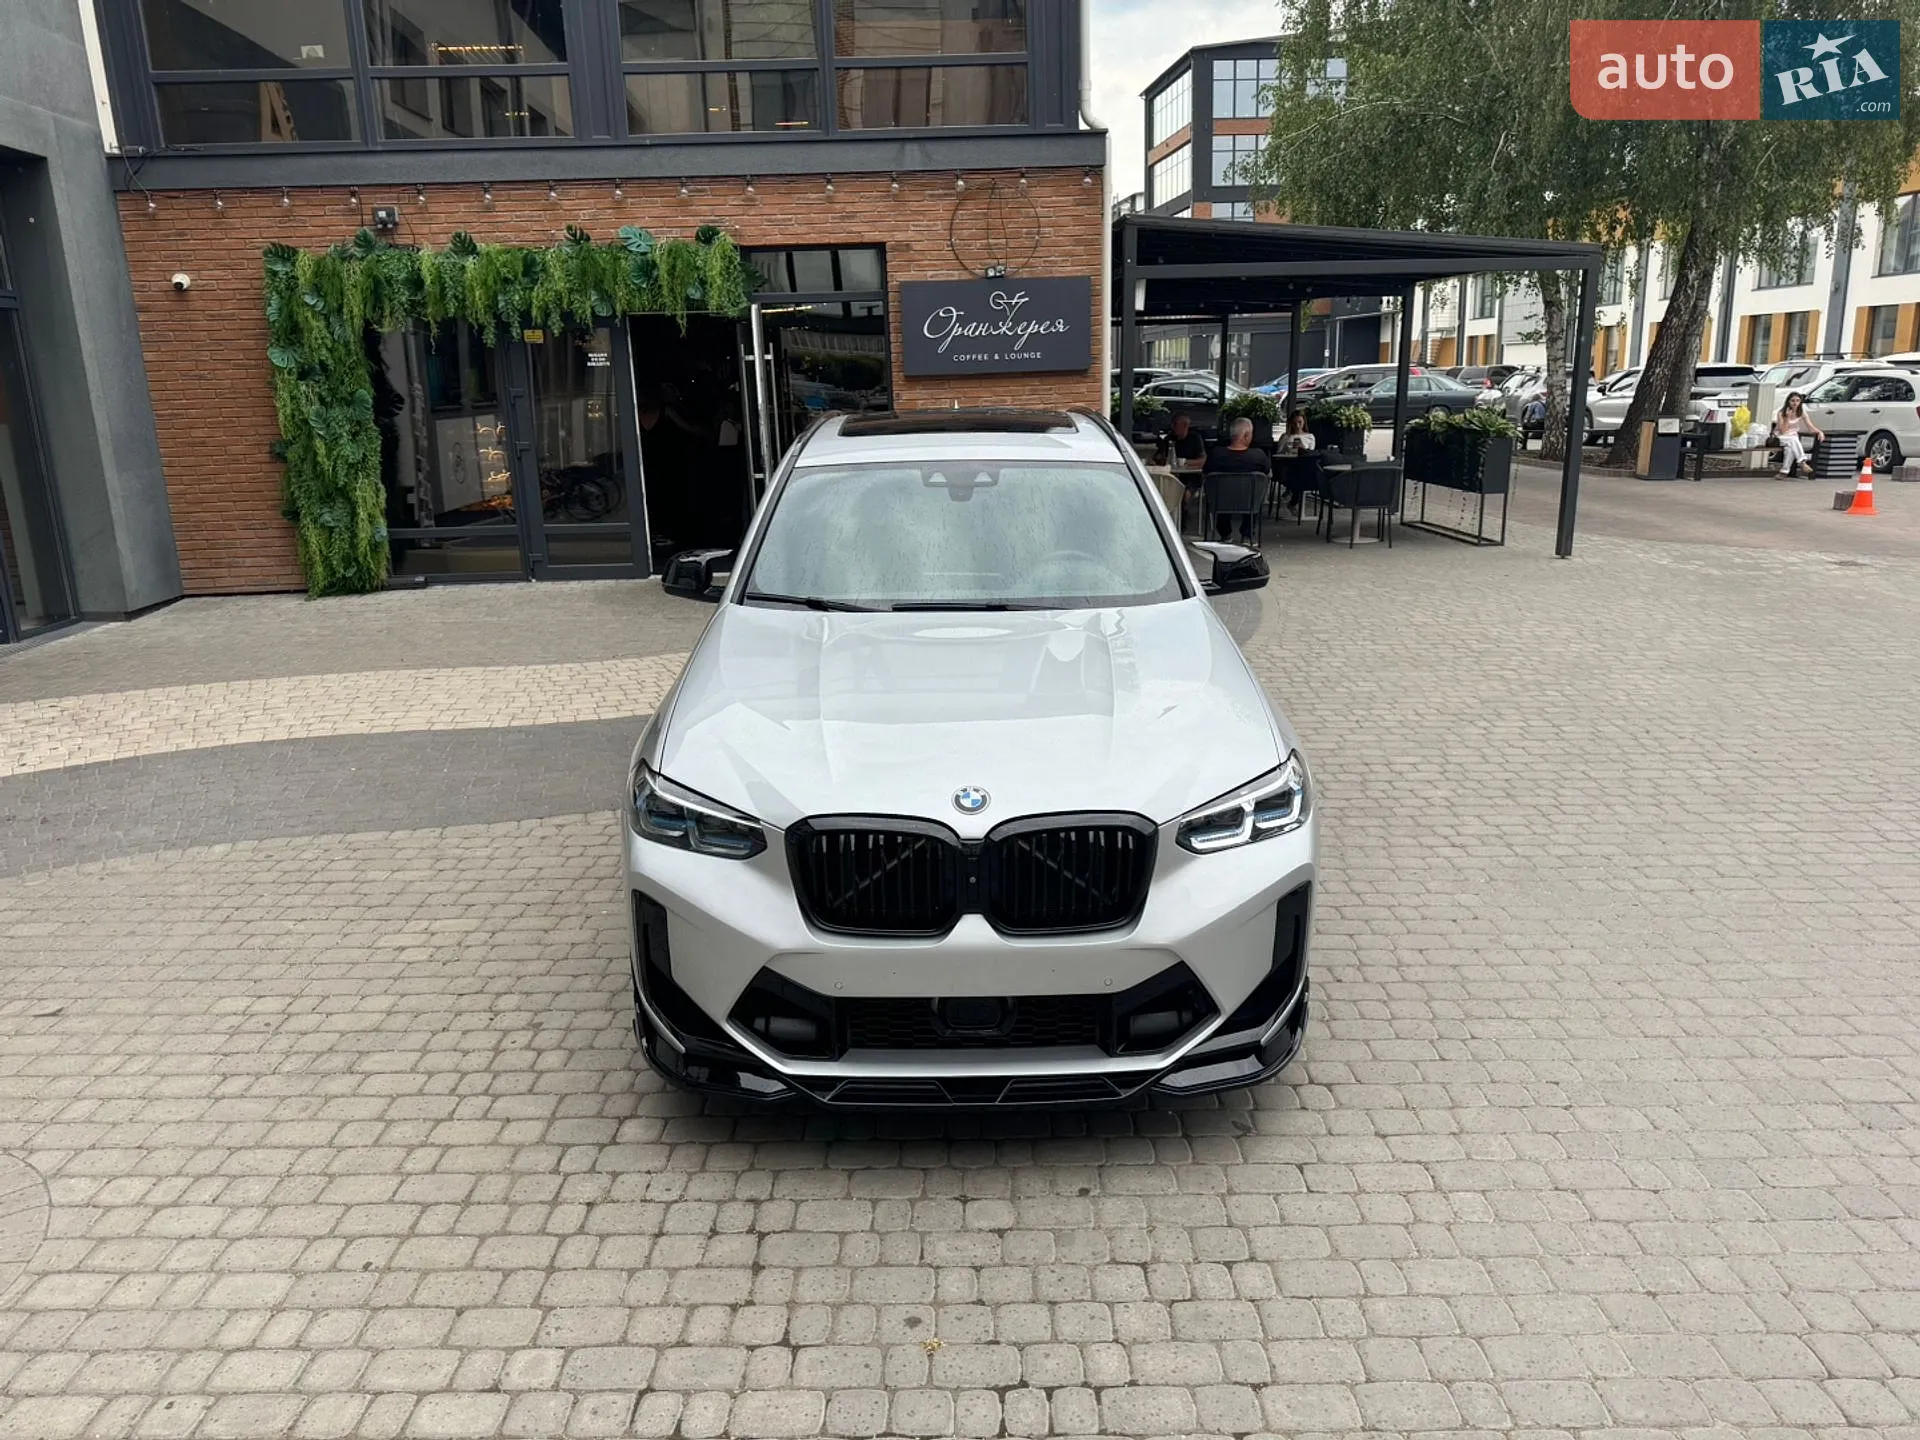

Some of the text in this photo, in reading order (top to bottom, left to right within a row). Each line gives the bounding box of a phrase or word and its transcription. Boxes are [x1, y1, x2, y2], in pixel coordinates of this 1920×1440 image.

[923, 306, 1070, 354] Оранжерея
[953, 351, 1042, 362] COFFEE & LOUNGE
